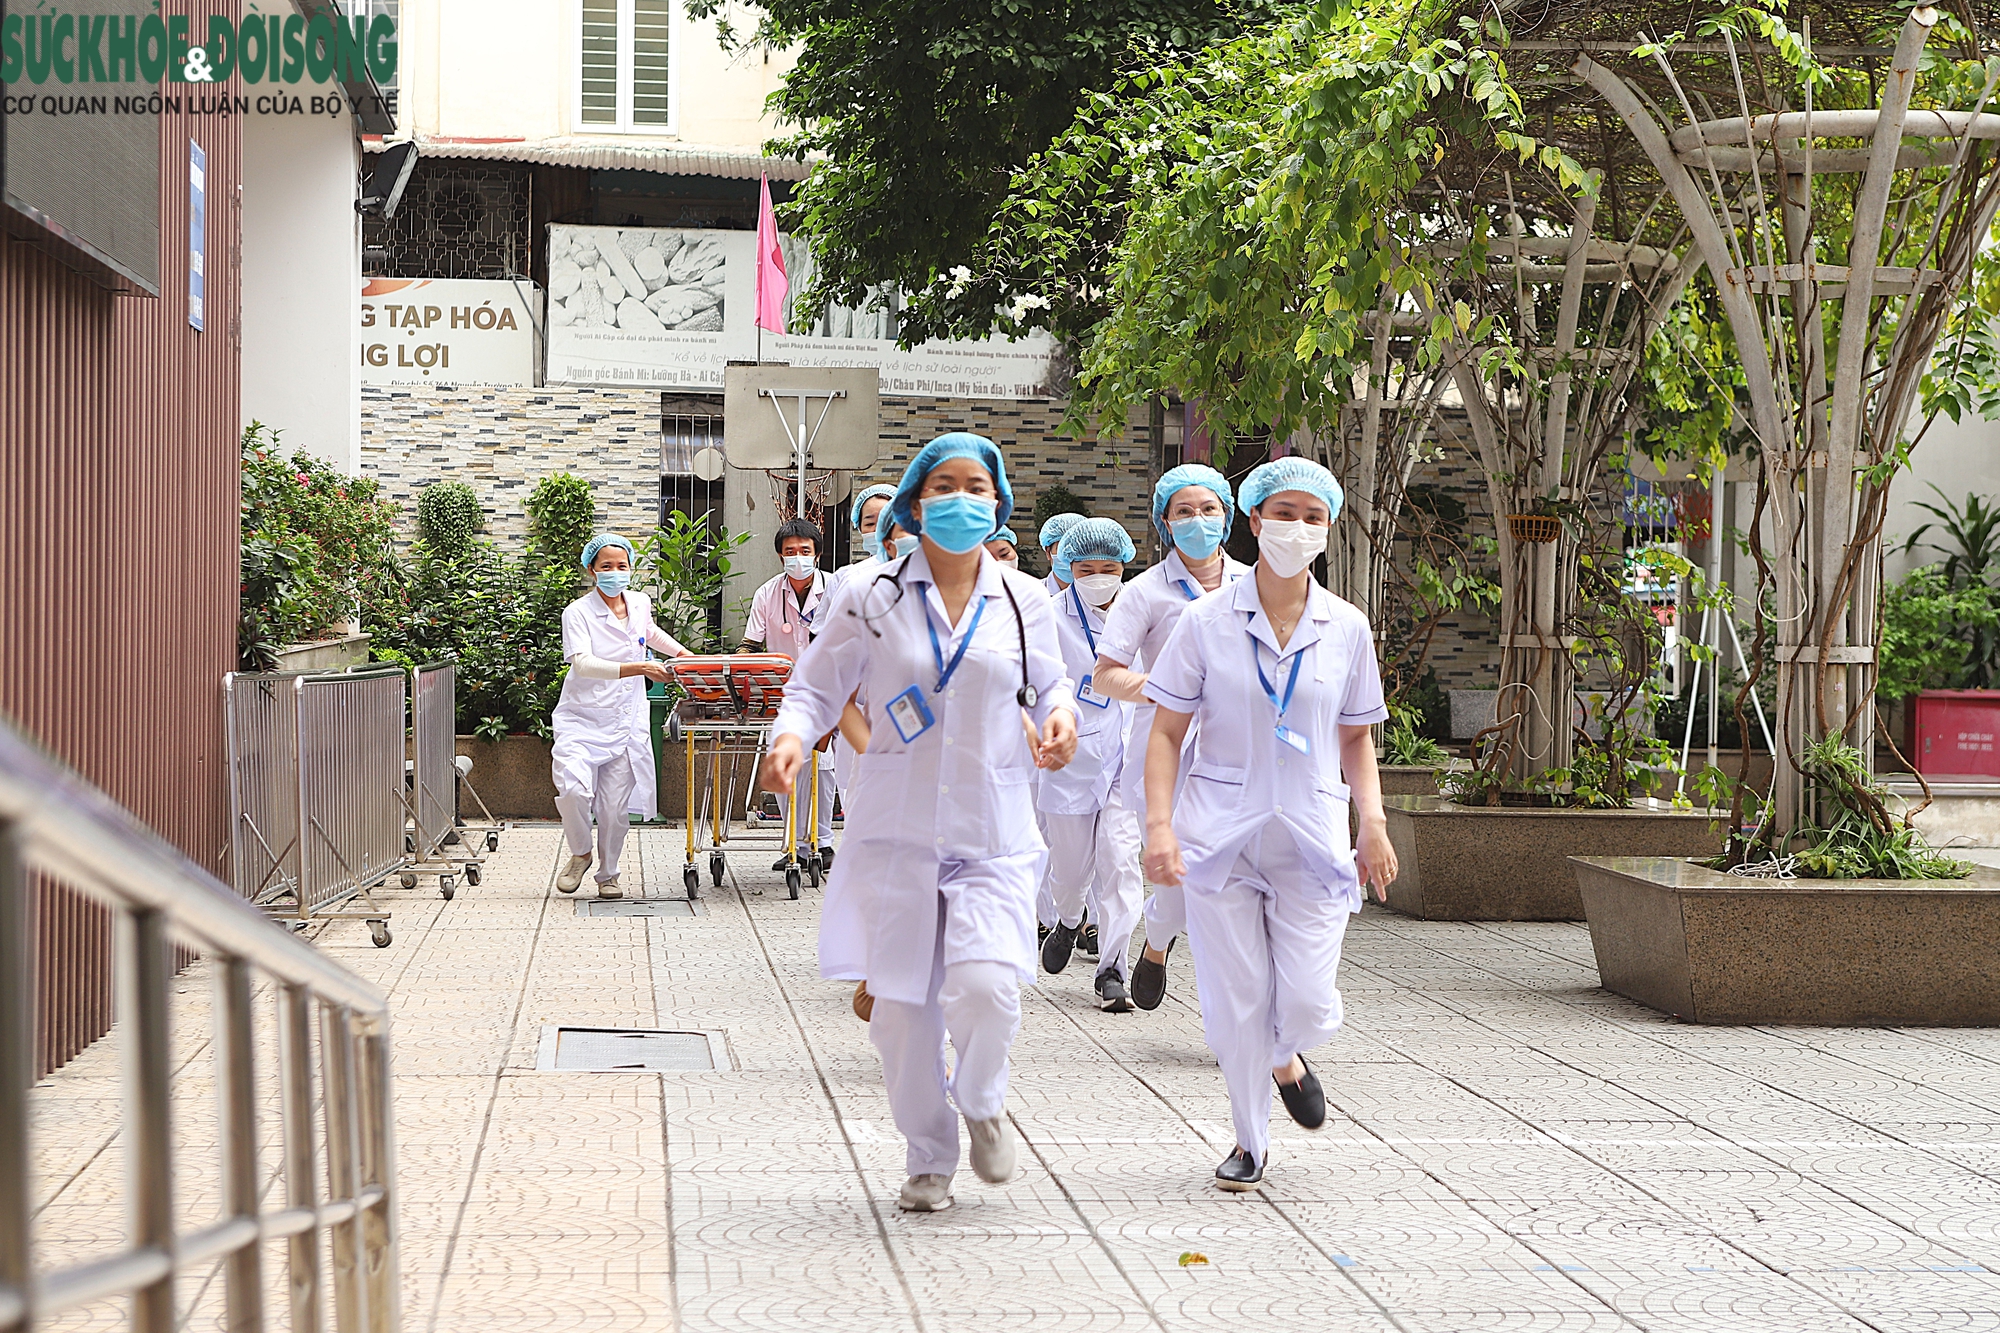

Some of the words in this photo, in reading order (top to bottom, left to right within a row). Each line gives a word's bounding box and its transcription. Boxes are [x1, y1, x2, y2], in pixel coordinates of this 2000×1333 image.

[384, 304, 442, 336] TẠP
[450, 300, 519, 331] HÓA
[602, 334, 616, 342] Cập
[398, 343, 449, 376] LỢI
[693, 352, 707, 363] về
[710, 353, 729, 365] lịch
[799, 358, 810, 366] là
[886, 359, 900, 371] về
[902, 362, 922, 373] lịch
[925, 362, 938, 372] sử
[940, 364, 962, 374] loài
[594, 365, 610, 381] gốc
[612, 367, 634, 380] Bánh
[680, 368, 692, 382] Hà
[699, 370, 708, 383] Ai
[973, 380, 988, 395] bản
[1014, 384, 1030, 398] Việt
